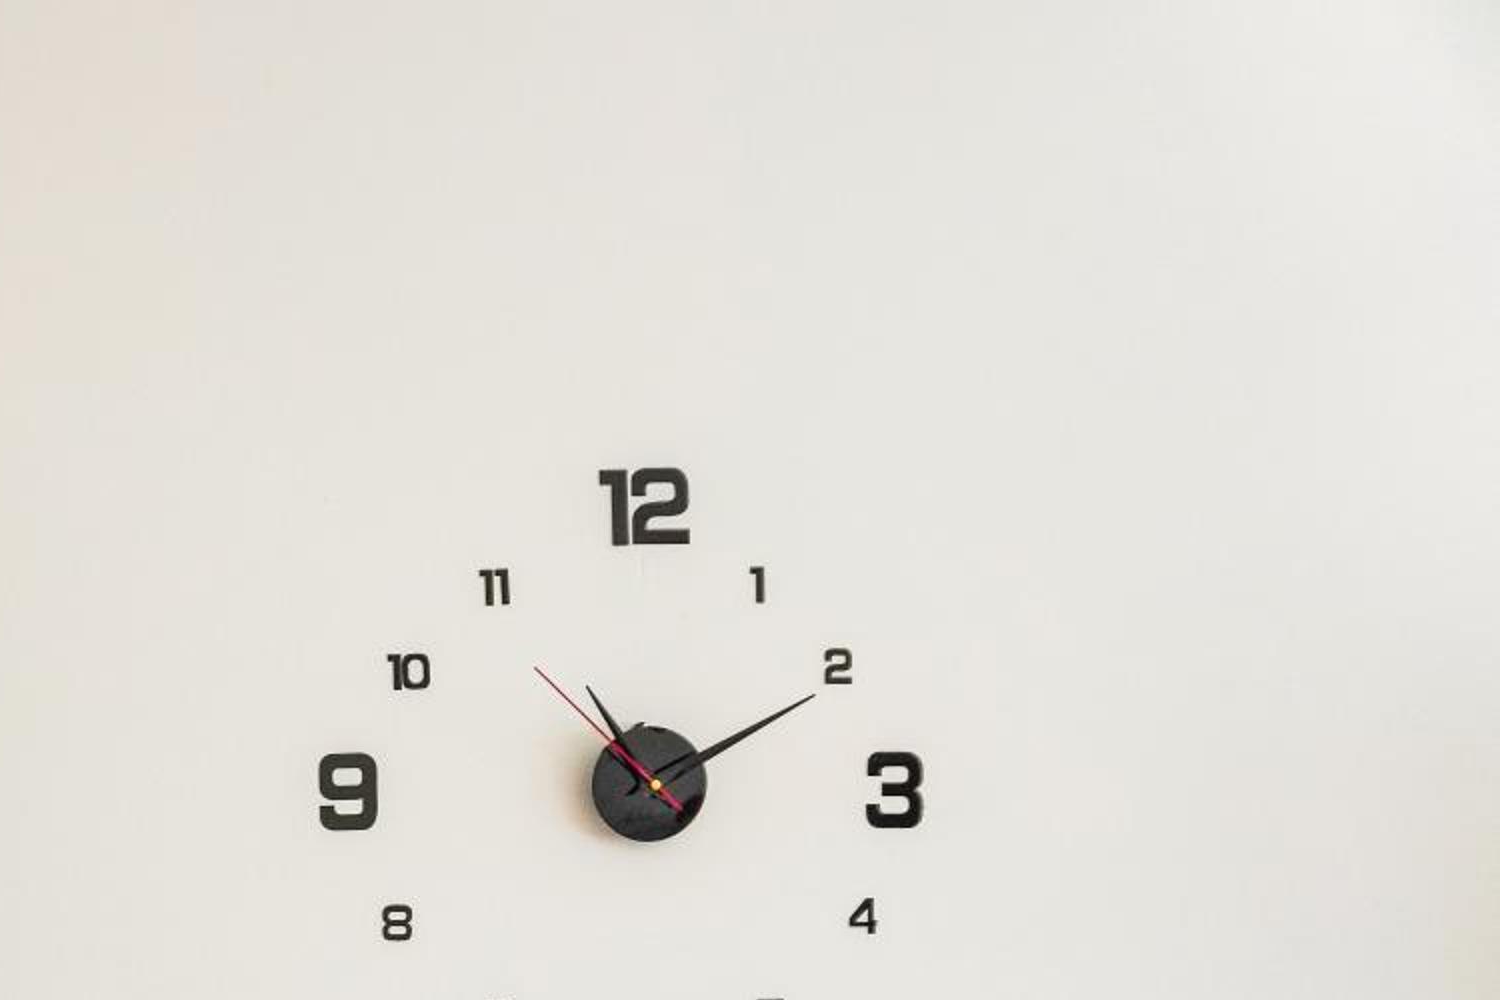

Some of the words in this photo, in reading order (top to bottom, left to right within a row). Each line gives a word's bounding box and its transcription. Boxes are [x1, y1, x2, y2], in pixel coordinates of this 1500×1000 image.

[598, 467, 691, 547] 12
[478, 568, 511, 607] 11
[749, 566, 766, 604] 1
[387, 653, 432, 691] 10
[824, 647, 853, 685] 2
[318, 752, 379, 832] 9
[865, 751, 924, 829] 3
[381, 904, 413, 942] 8
[848, 897, 878, 935] 4
